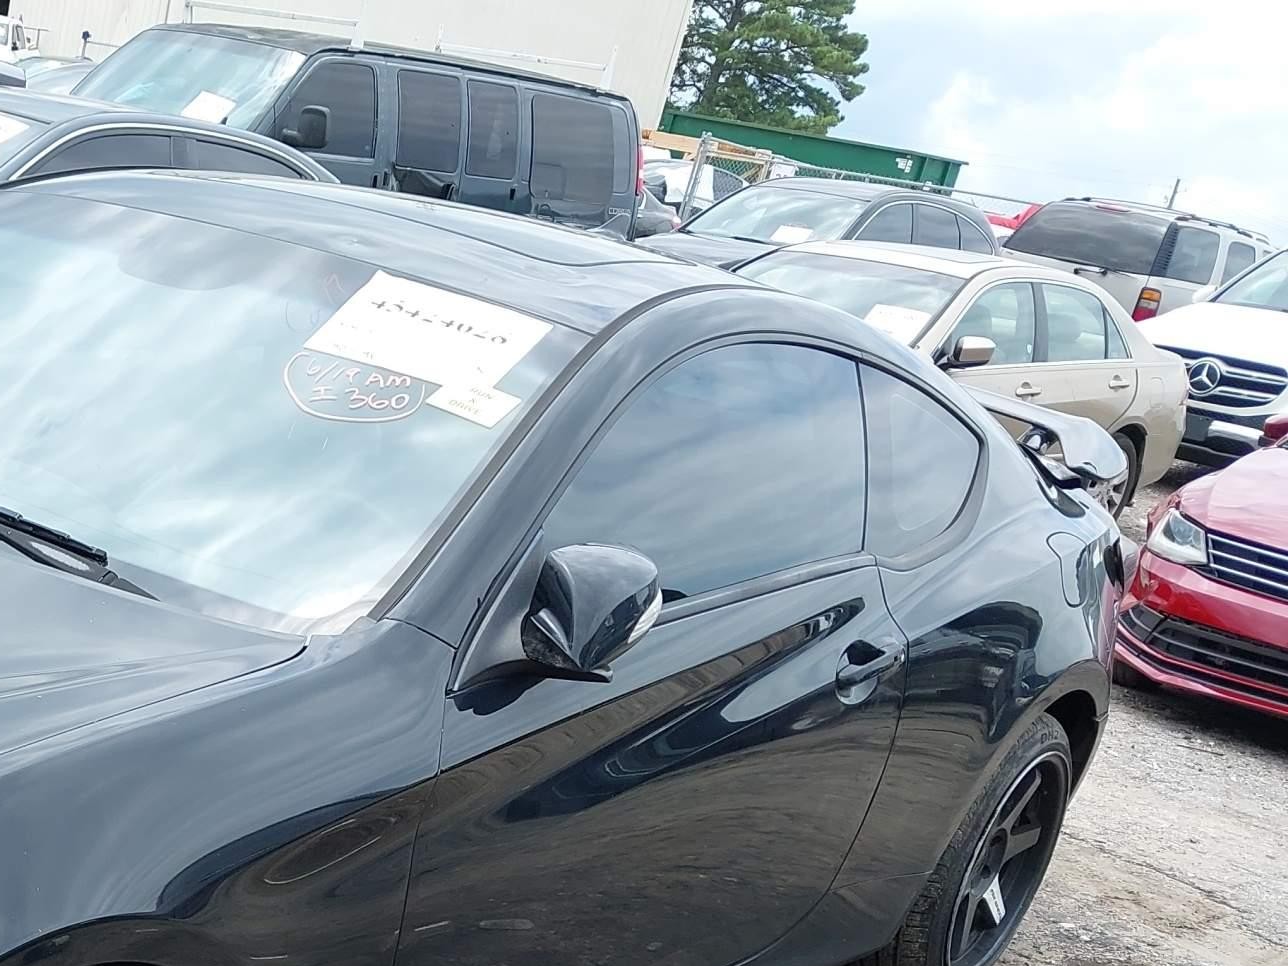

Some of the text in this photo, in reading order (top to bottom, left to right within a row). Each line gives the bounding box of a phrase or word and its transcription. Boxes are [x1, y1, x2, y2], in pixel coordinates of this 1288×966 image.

[305, 356, 412, 388] 6/19 AM
[344, 387, 410, 410] 360
[448, 399, 482, 415] DRIVE
